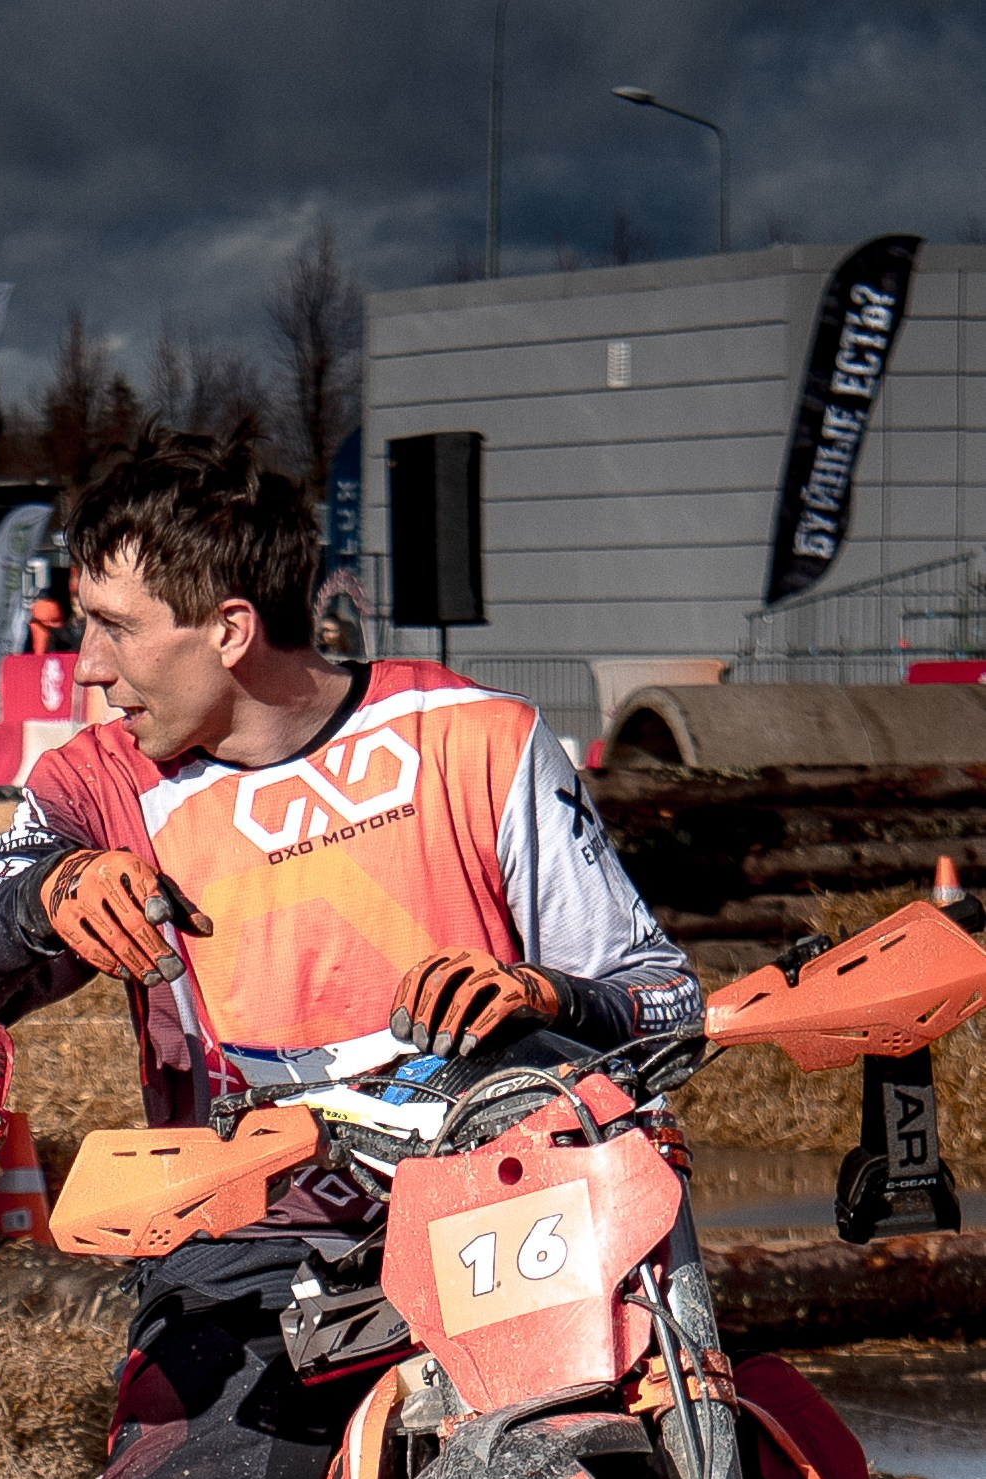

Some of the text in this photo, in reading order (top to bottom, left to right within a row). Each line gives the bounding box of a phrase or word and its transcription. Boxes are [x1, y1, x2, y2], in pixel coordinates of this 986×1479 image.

[830, 283, 896, 400] ЕСТЬ?
[268, 803, 416, 865] OXO MOTORS
[459, 1214, 568, 1297] 16
